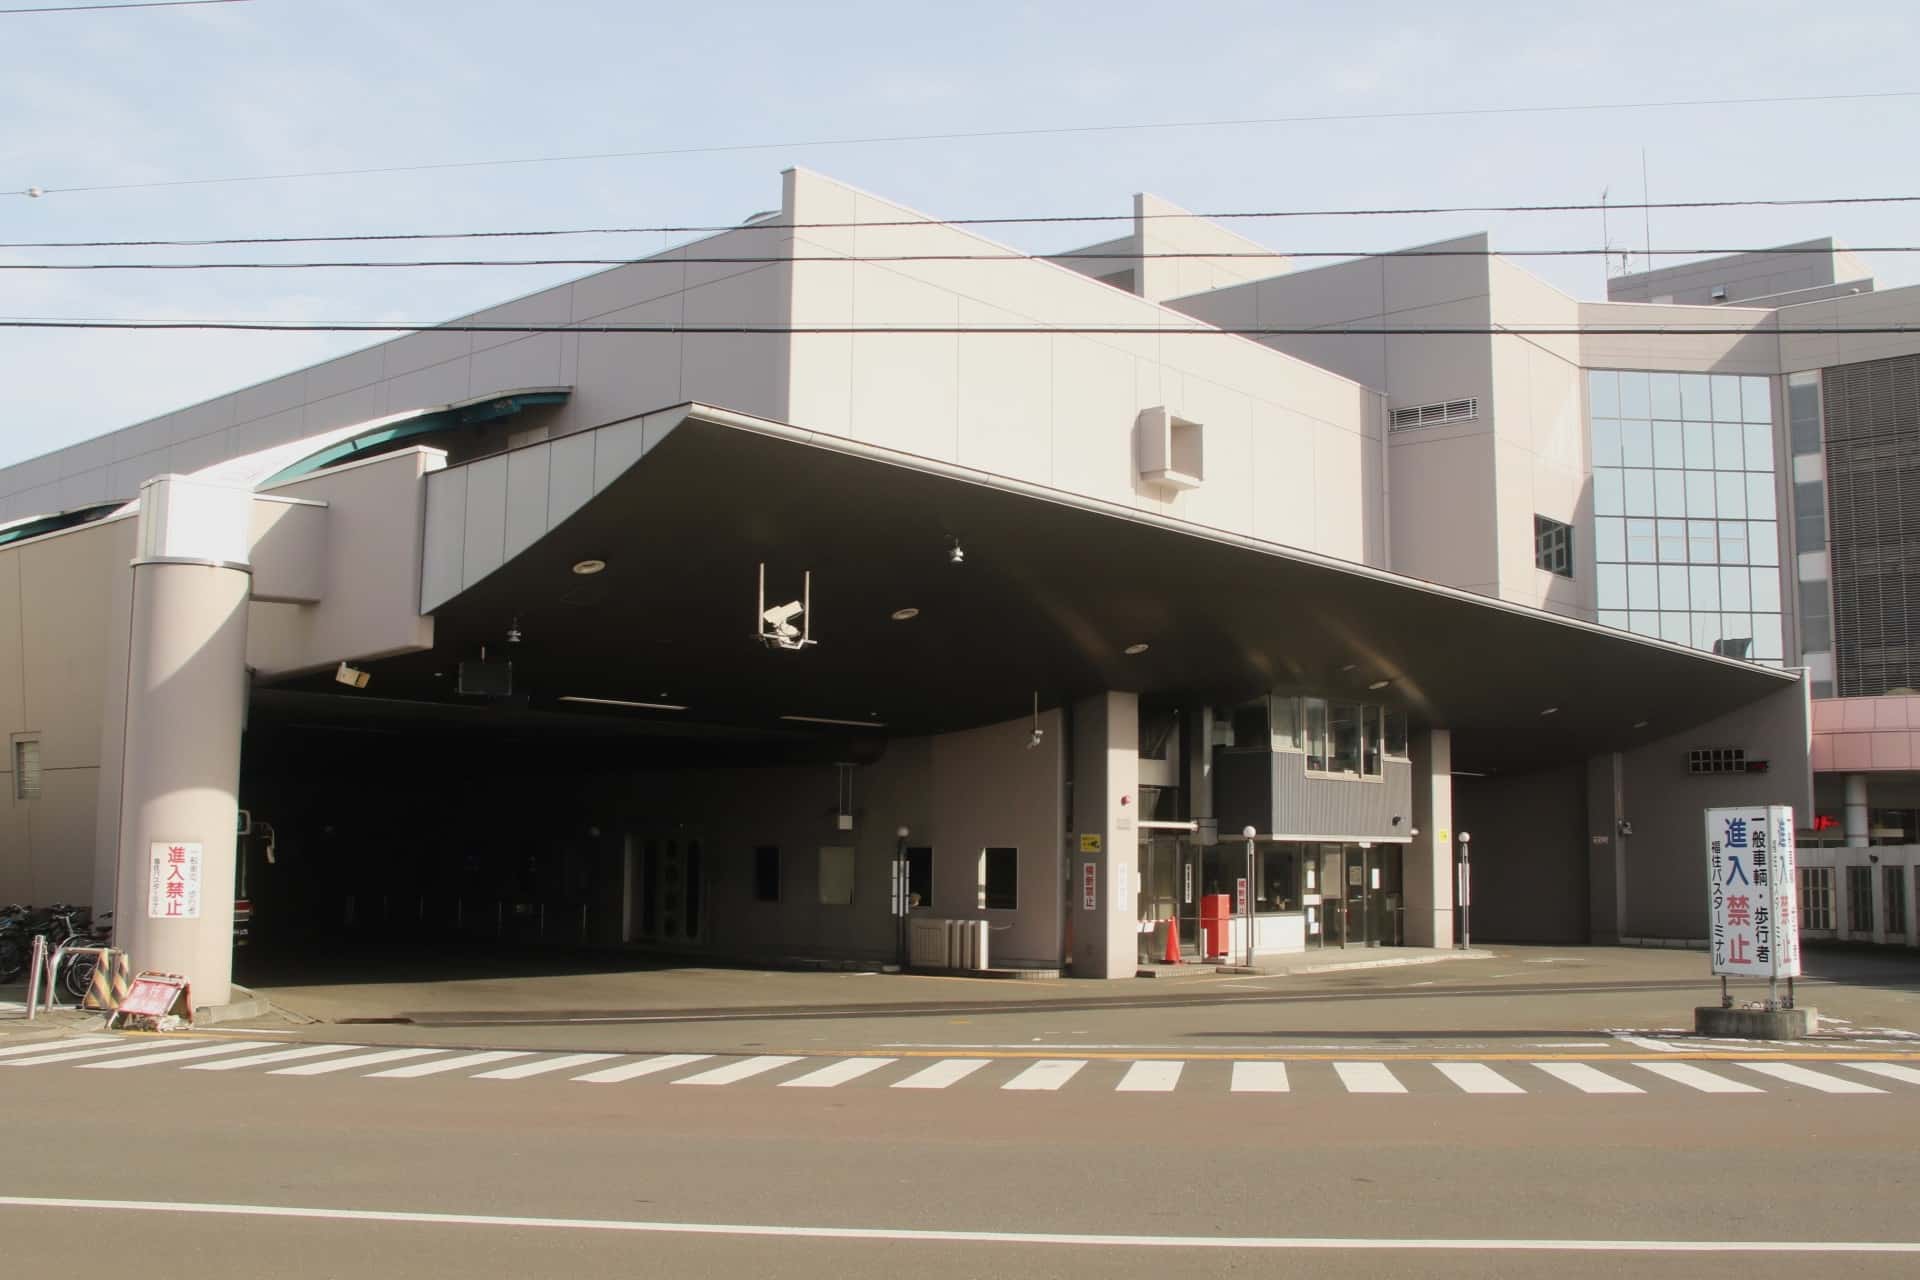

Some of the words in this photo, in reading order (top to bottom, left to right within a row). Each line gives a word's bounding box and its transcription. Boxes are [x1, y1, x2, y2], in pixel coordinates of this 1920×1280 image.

[166, 846, 185, 916] 進入禁止
[1711, 841, 1725, 966] 福住バスターミナル
[1724, 817, 1751, 965] 進入禁止
